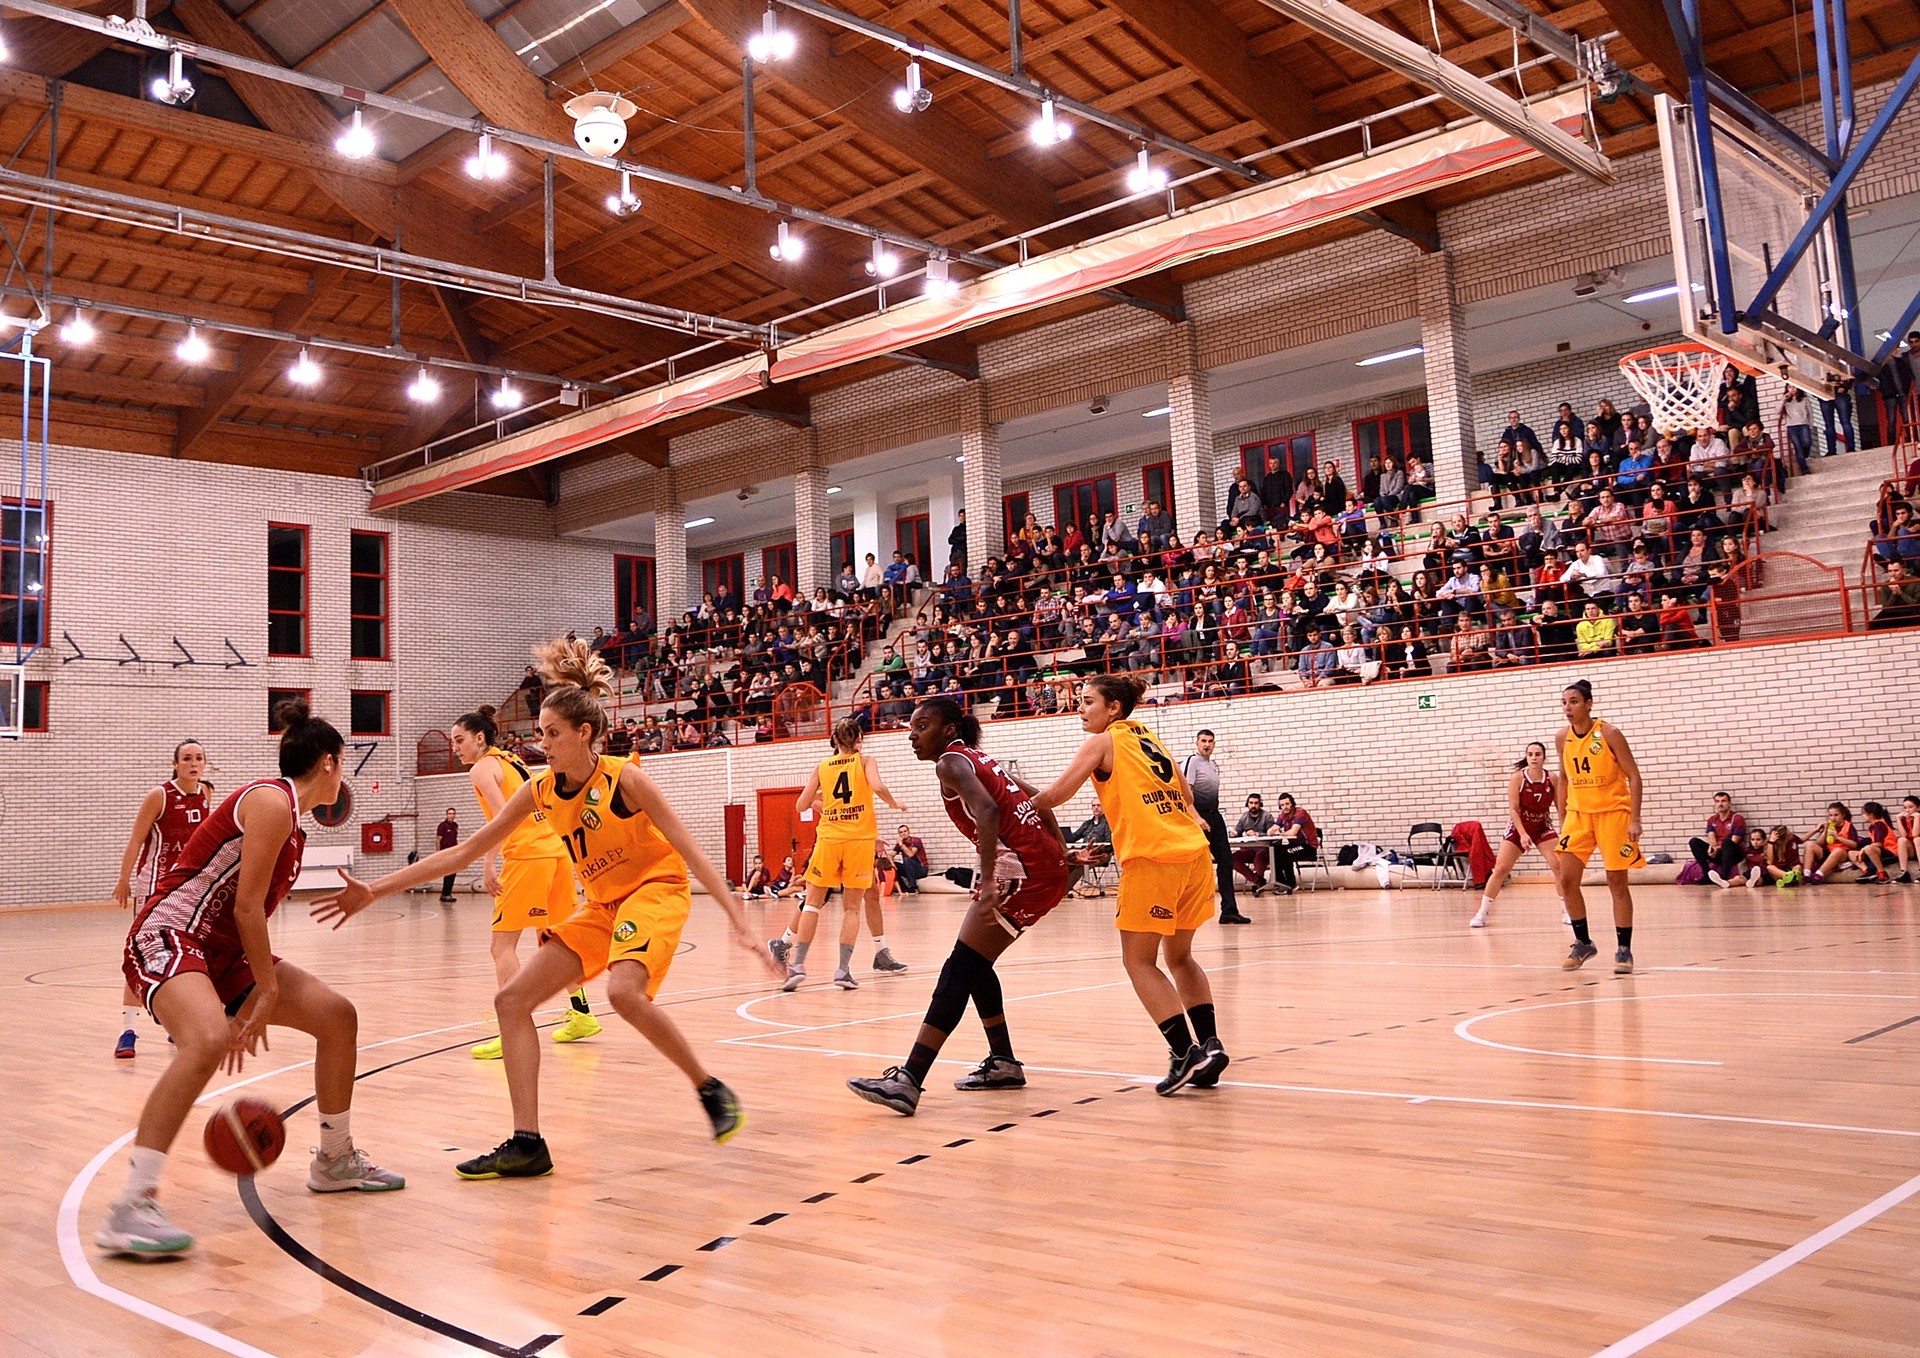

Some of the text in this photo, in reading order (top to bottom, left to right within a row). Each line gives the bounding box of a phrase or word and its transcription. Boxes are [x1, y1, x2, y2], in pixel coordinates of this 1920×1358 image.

[1138, 738, 1174, 783] 5
[1573, 757, 1591, 774] 14
[832, 771, 852, 804] 4
[1142, 790, 1165, 804] CLUB
[1533, 793, 1542, 802] 7
[839, 805, 864, 814] JOVENTUT
[1156, 802, 1173, 814] LES
[185, 809, 201, 823] 10
[562, 827, 588, 863] 17
